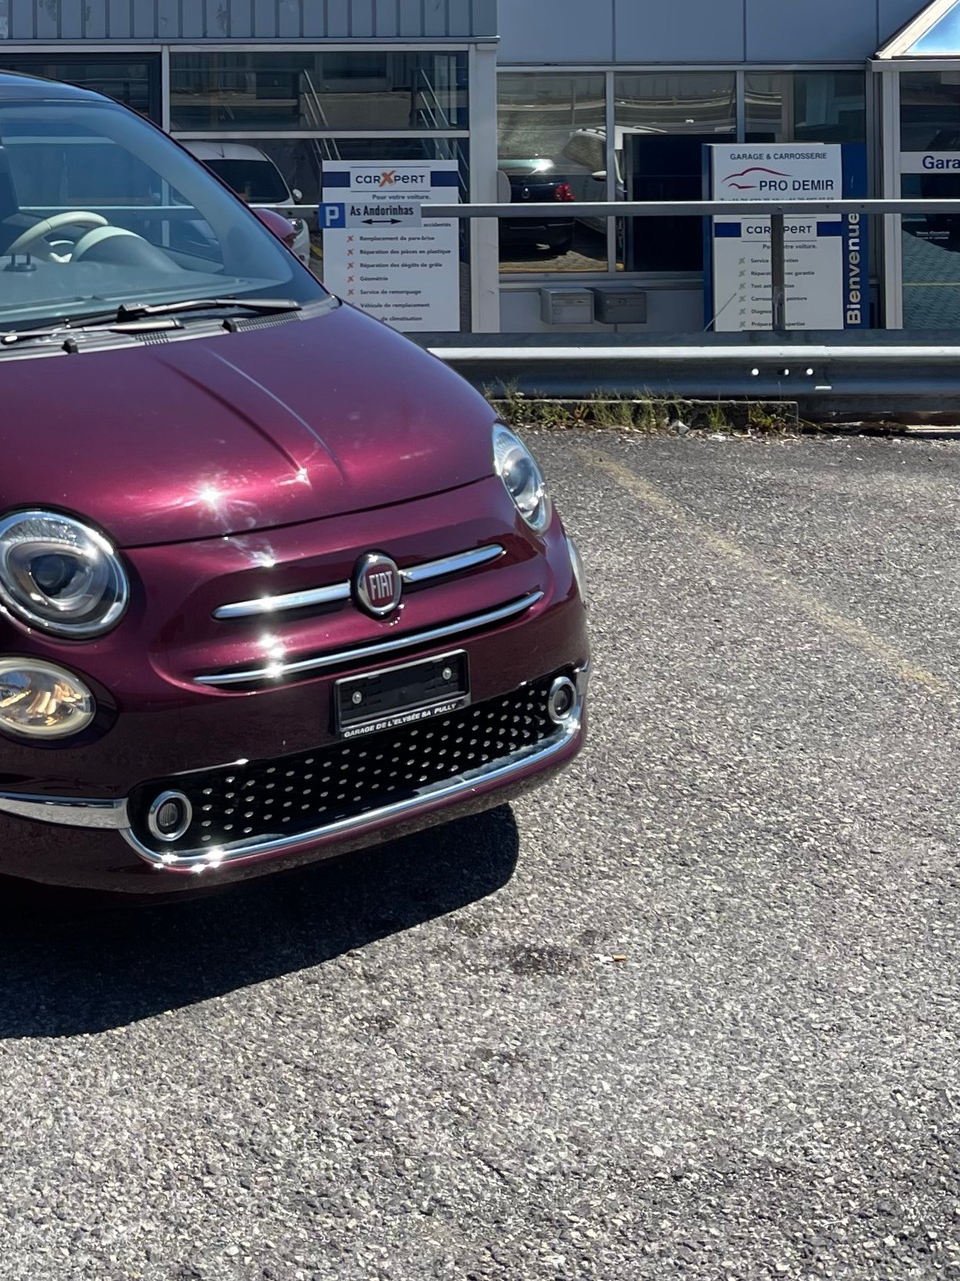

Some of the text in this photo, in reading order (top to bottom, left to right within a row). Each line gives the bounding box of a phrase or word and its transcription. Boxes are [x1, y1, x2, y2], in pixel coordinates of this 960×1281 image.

[766, 152, 771, 160] &
[773, 152, 827, 160] CARROSSERIE
[922, 155, 960, 169] Gara
[759, 179, 834, 191] PRO DEMIR
[325, 205, 414, 227] P As Andorinhas
[846, 213, 861, 324] Bienvenue
[369, 571, 393, 600] FIAT
[344, 725, 375, 738] GARAGE
[376, 721, 387, 730] DE
[434, 703, 457, 714] PULLY
